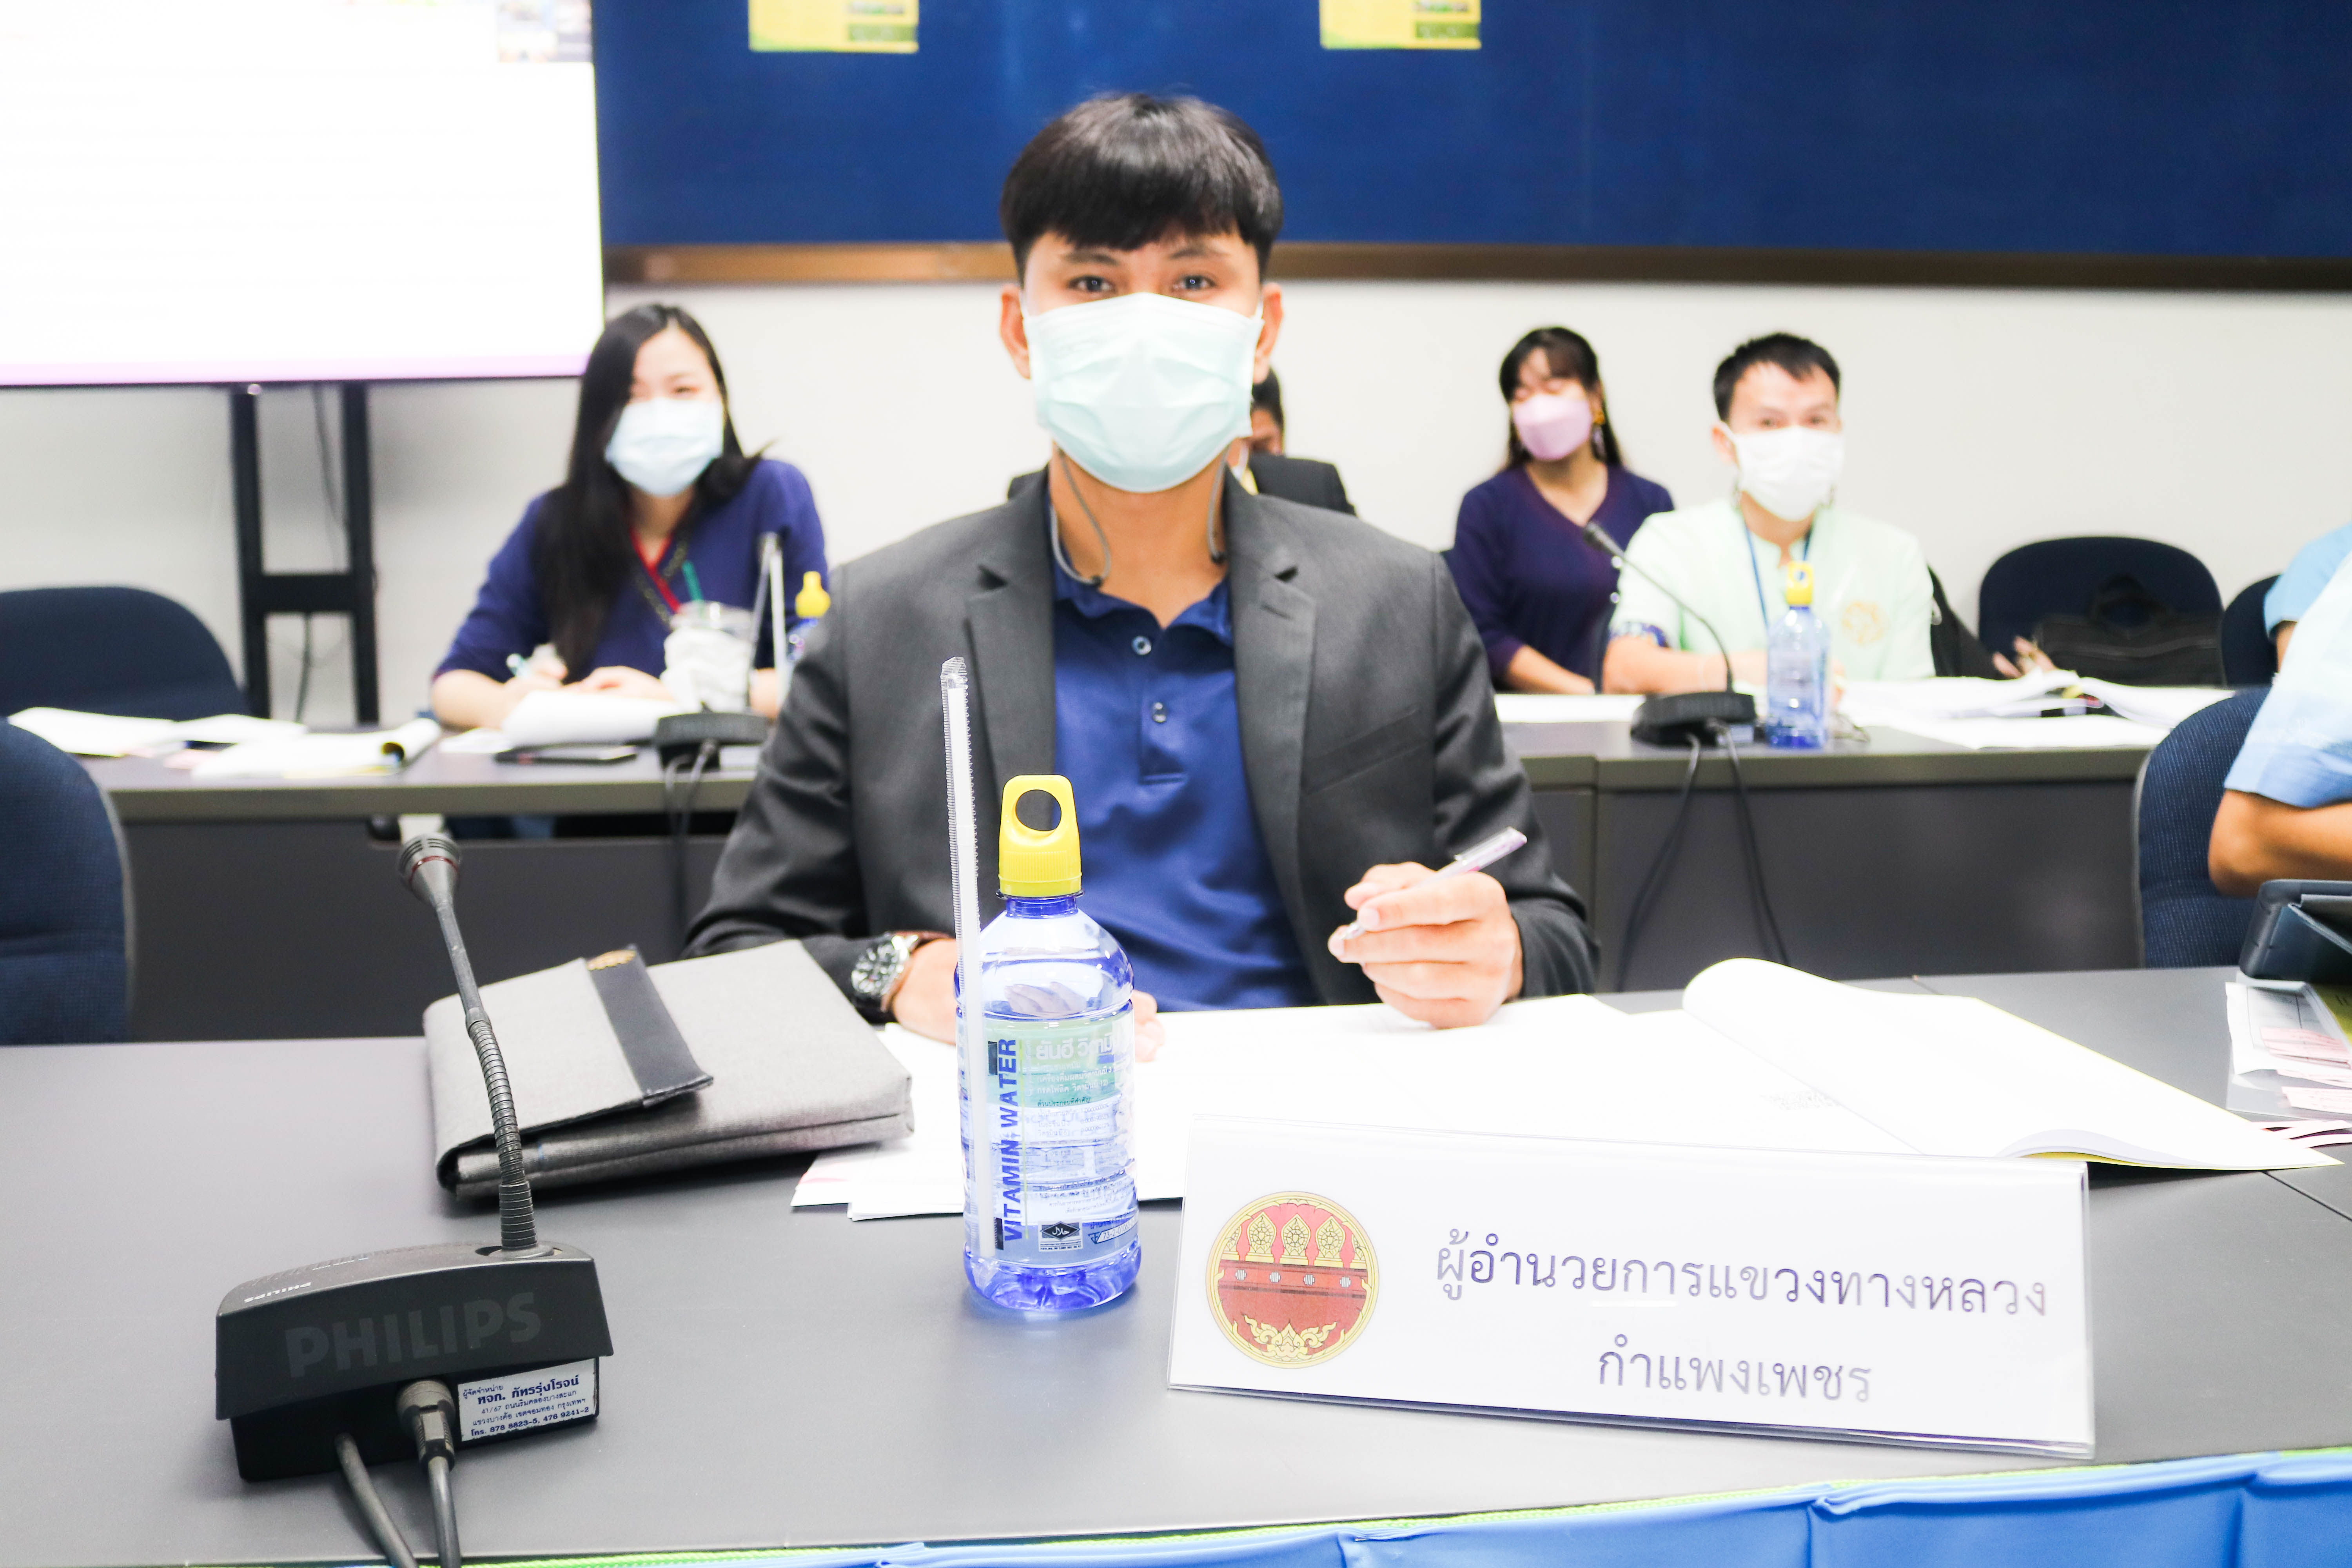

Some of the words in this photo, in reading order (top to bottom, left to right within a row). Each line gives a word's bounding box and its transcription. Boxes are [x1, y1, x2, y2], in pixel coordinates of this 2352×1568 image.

[998, 1039, 1019, 1128] WATER
[1001, 1139, 1022, 1241] VITAMIN
[1052, 1226, 1070, 1236] حلال
[1437, 1228, 2046, 1316] ผู้อำนวยการแขวงทางหลวง
[244, 1282, 311, 1303] PHILIPS
[285, 1292, 541, 1377] PHILIPS
[1599, 1333, 1871, 1403] กำแพงเพชร
[463, 1384, 504, 1400] ผู้จัดจำหน่าย
[477, 1393, 506, 1405] หจก.
[557, 1397, 587, 1411] กรุงเทพฯ
[490, 1424, 505, 1433] 878
[543, 1414, 558, 1422] 476
[560, 1406, 590, 1418] 9241-2
